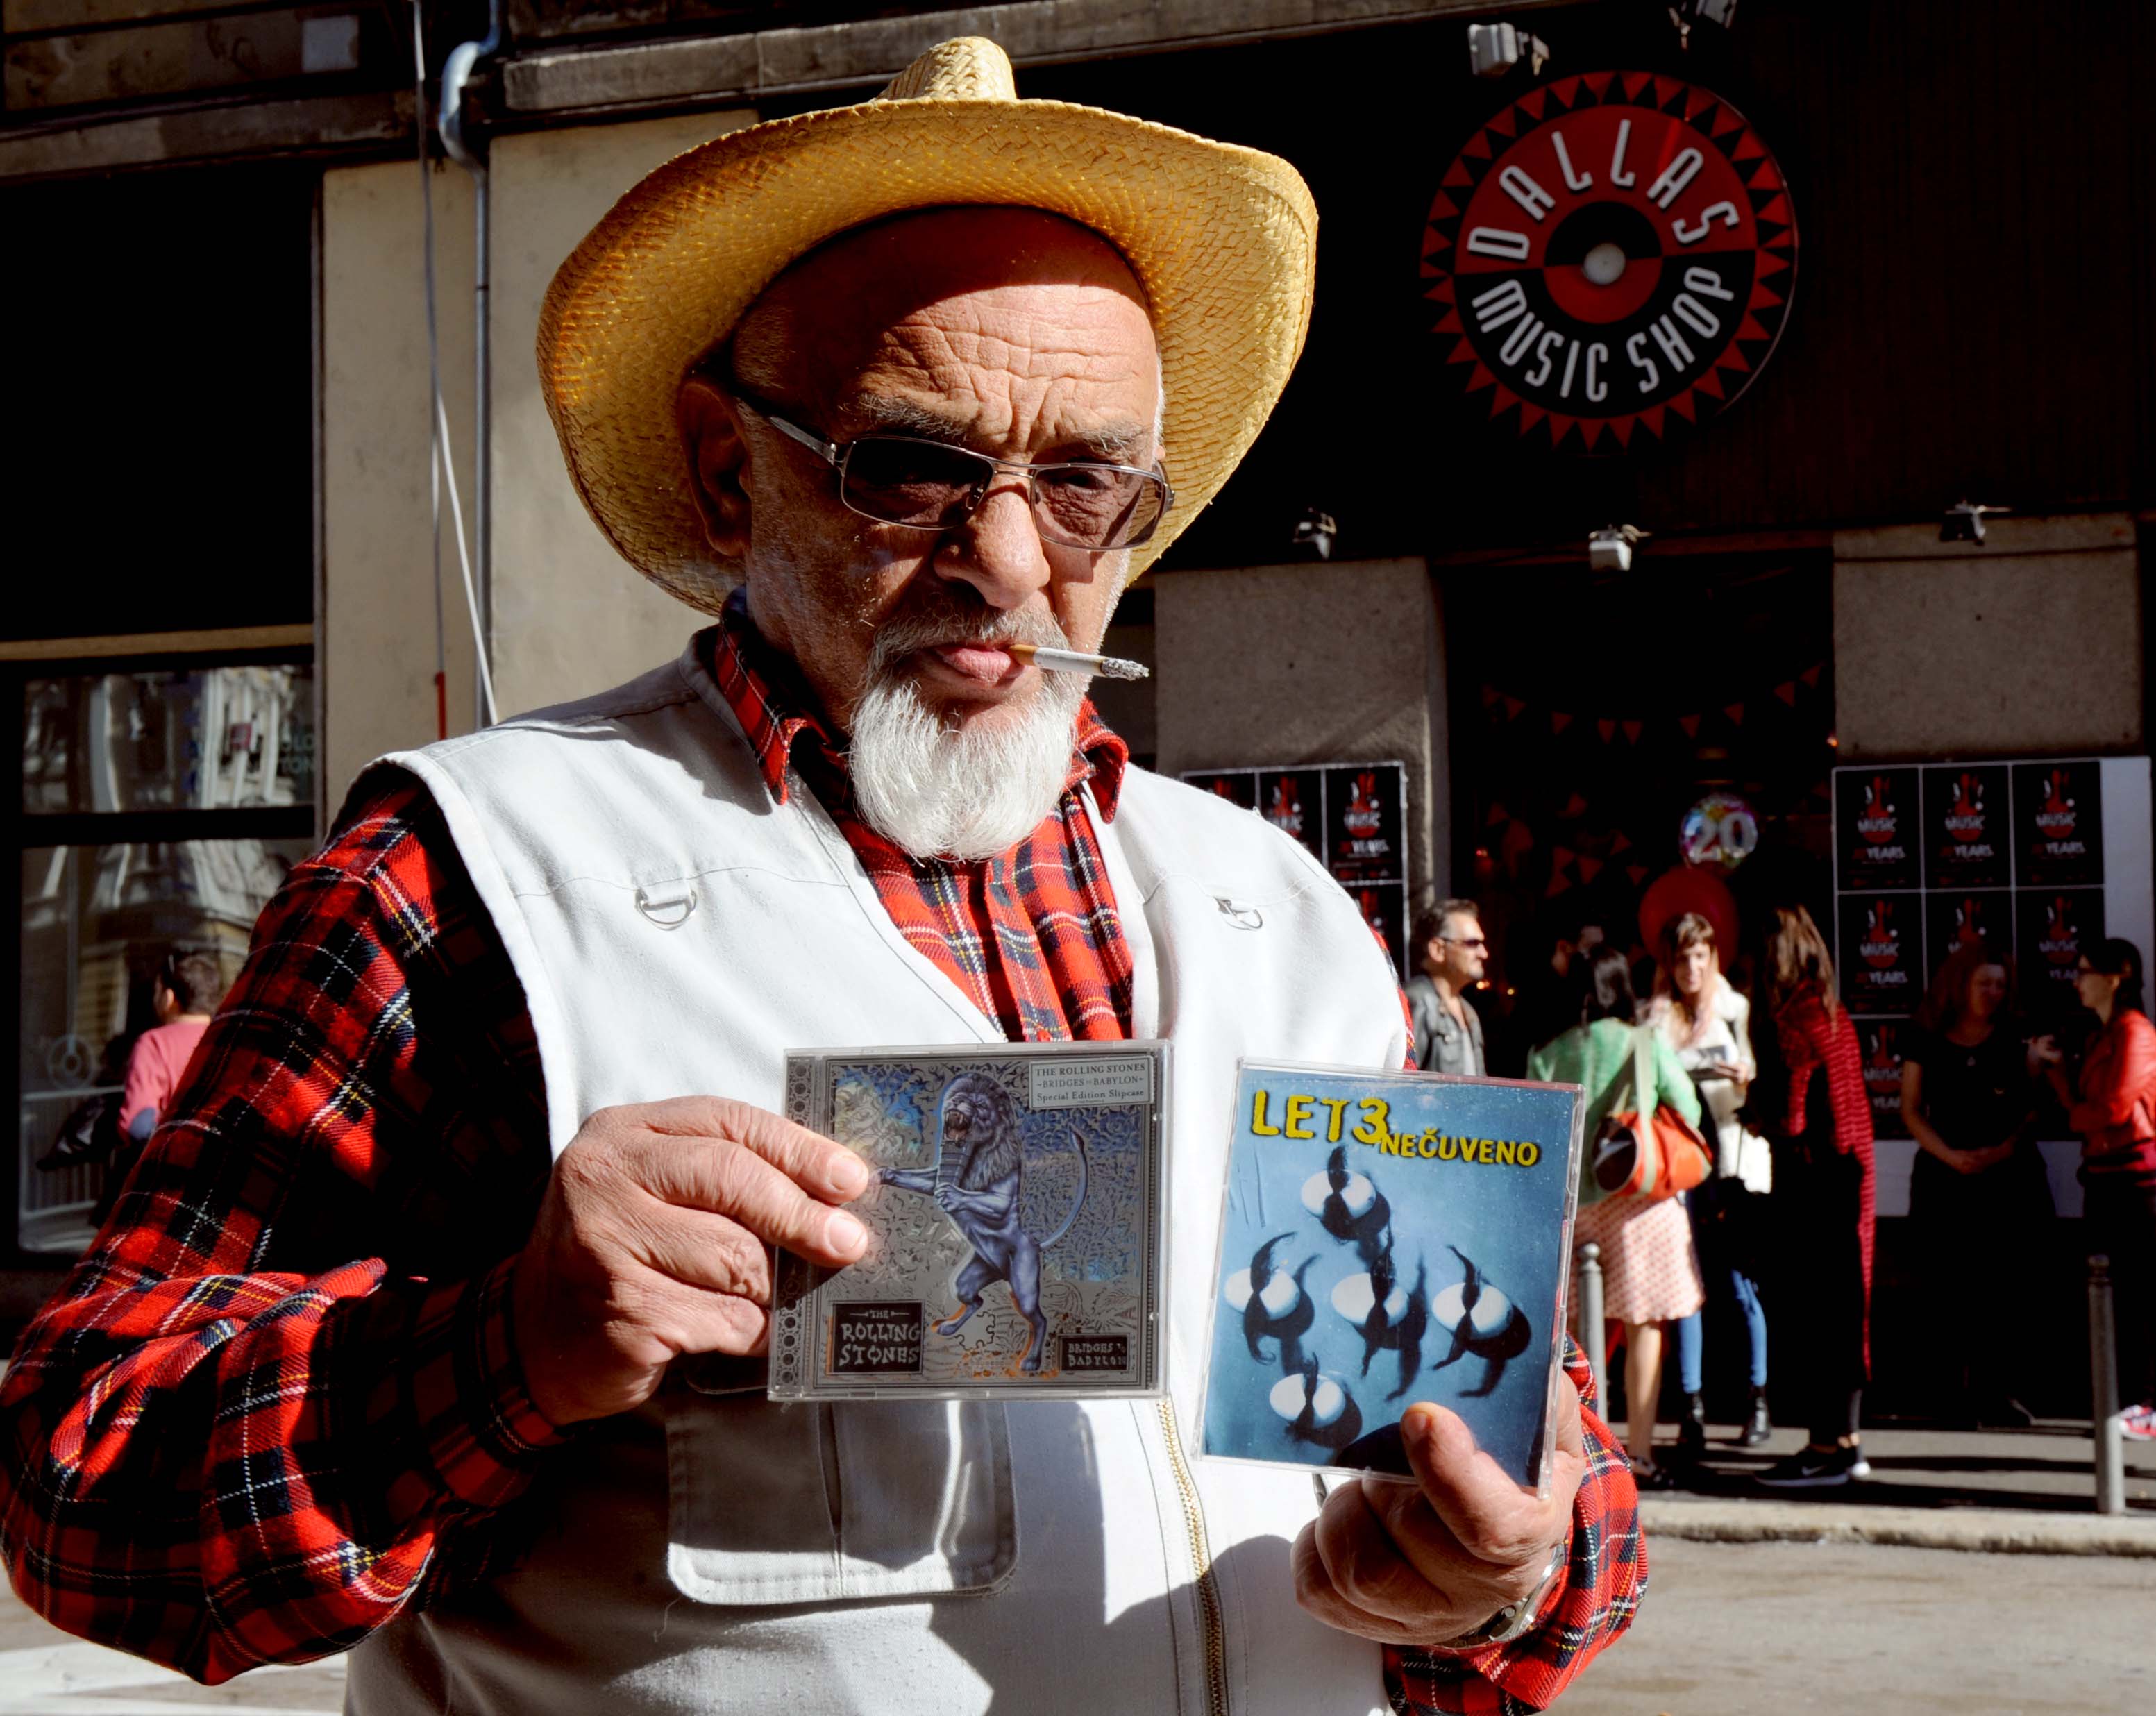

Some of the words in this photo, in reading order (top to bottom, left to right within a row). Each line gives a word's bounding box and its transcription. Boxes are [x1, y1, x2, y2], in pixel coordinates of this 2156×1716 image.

[1467, 119, 1740, 260] DALLAS
[1472, 279, 1609, 401] MUSIC
[1626, 267, 1735, 394] SHOP
[1685, 810, 1758, 864] 20
[1036, 1068, 1056, 1076] THE
[1059, 1066, 1104, 1075] ROLLING
[1106, 1063, 1145, 1073] STONES
[1043, 1079, 1084, 1088] BRIDGES
[1093, 1076, 1138, 1086] BABYLON
[1037, 1092, 1068, 1102] Special
[1072, 1090, 1106, 1100] Edition
[1109, 1088, 1145, 1099] Slipcase
[1380, 1127, 1539, 1167] NEČUVENO
[870, 1309, 889, 1319] THE
[840, 1321, 921, 1343] ROLLING
[839, 1343, 920, 1367] STONES
[1068, 1342, 1114, 1354] BRIDGES
